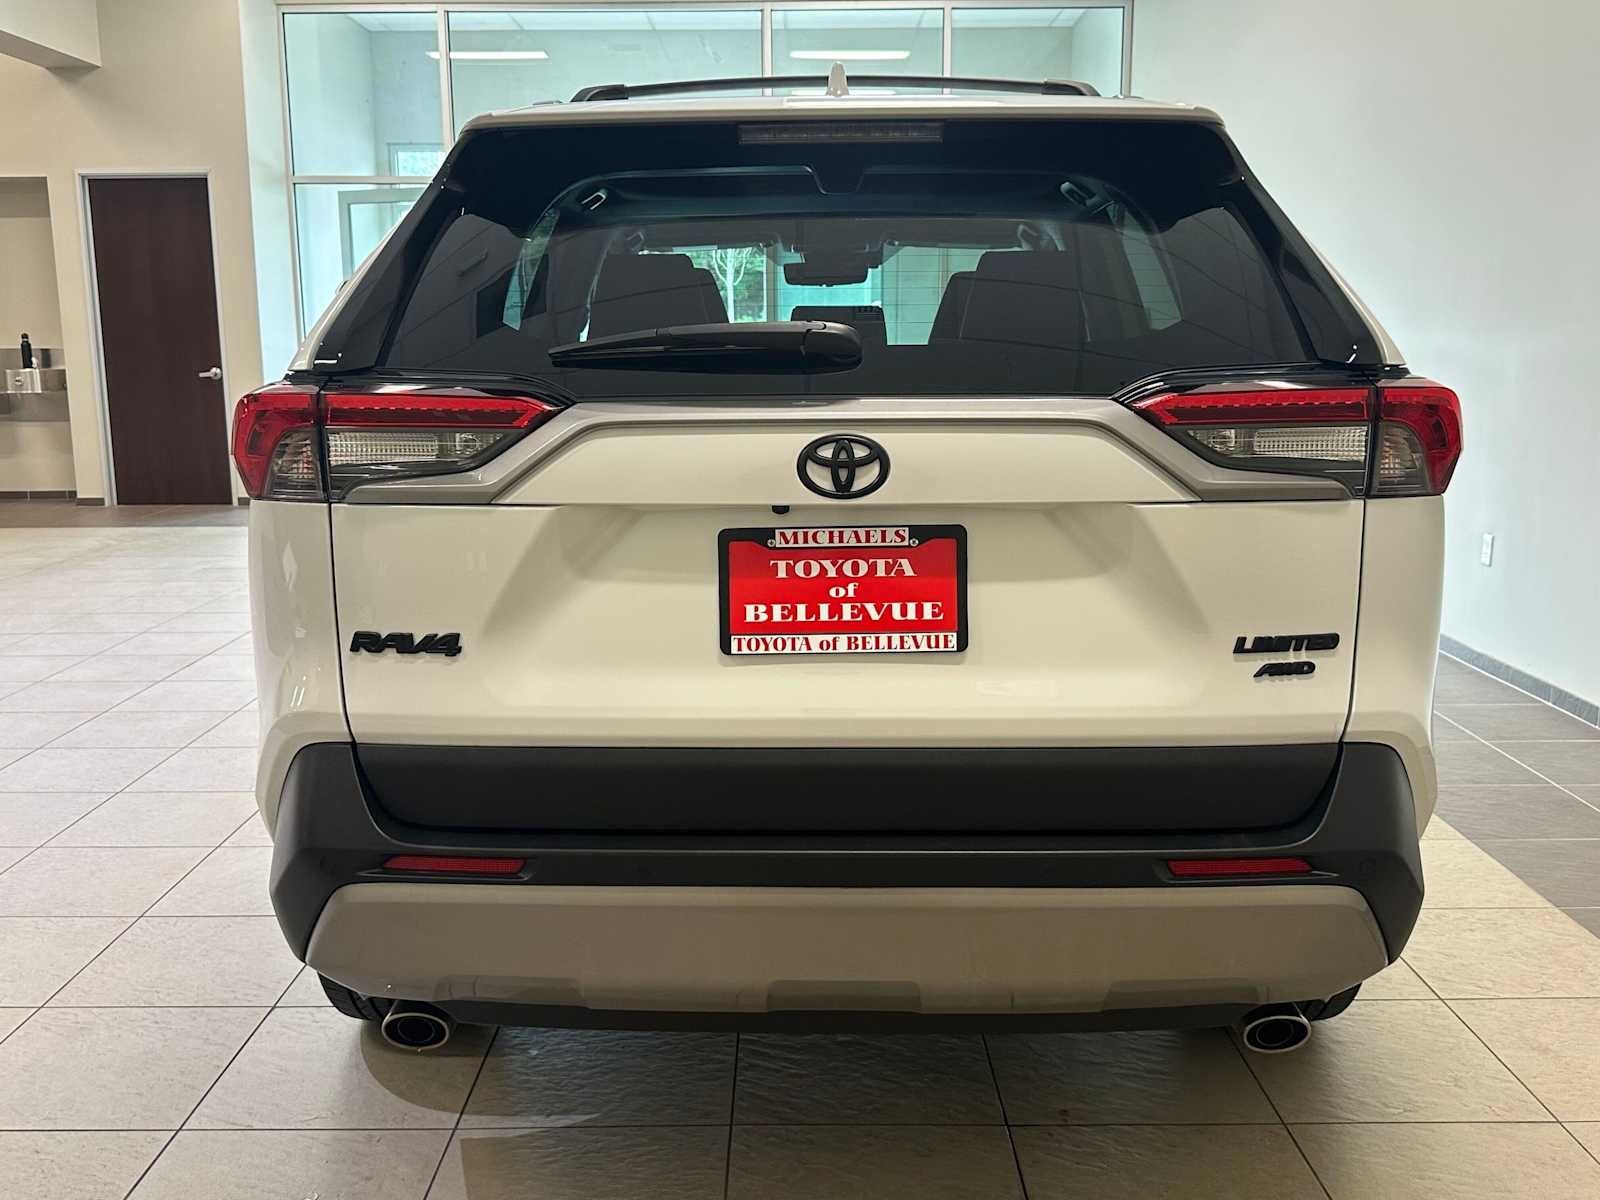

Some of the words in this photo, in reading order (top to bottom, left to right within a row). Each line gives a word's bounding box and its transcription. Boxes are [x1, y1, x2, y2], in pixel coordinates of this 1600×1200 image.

[778, 528, 907, 546] MICHAELS
[770, 558, 917, 579] TOYOTA
[828, 582, 859, 599] of
[744, 601, 944, 623] BELLEVUE
[350, 631, 462, 657] RAV4
[733, 636, 813, 653] TOYOTA
[819, 635, 840, 651] of
[847, 633, 955, 651] BELLEVUE
[1232, 632, 1340, 654] LIMITED
[1253, 661, 1316, 678] AWD
